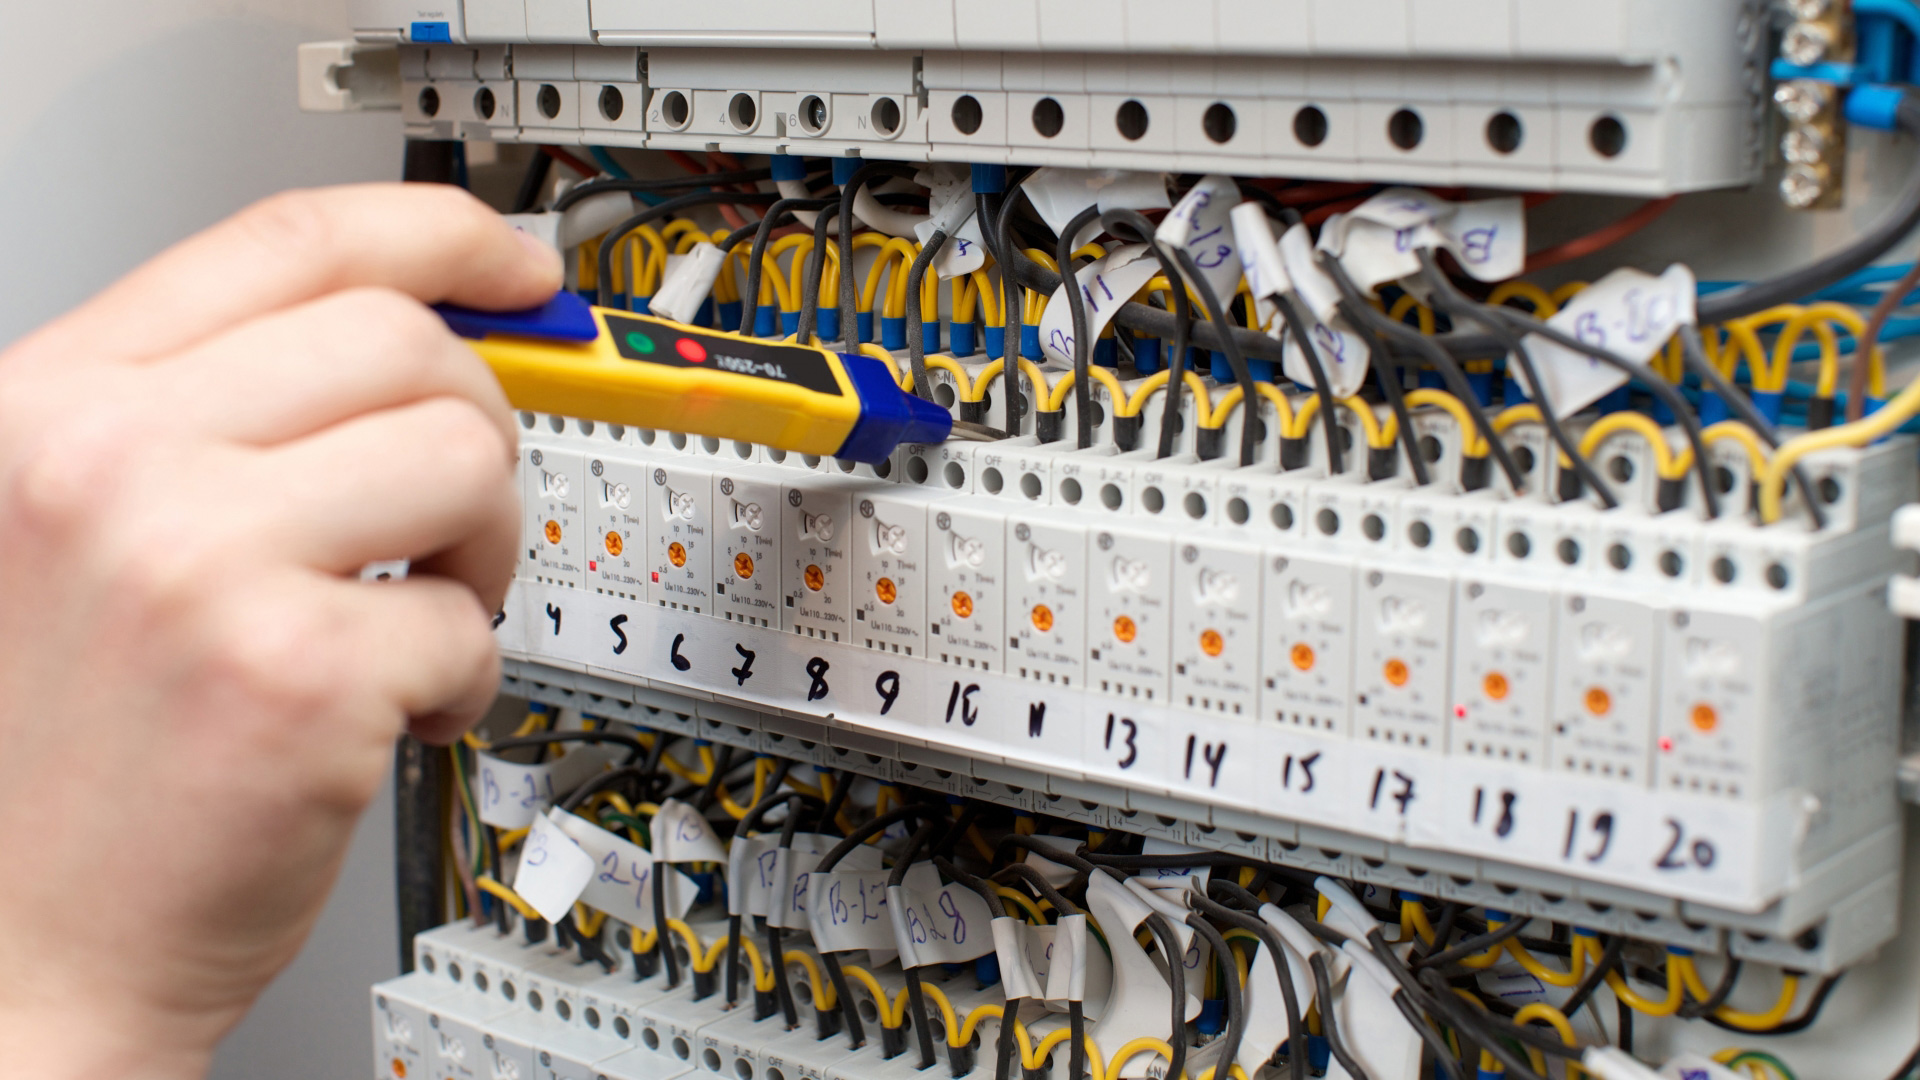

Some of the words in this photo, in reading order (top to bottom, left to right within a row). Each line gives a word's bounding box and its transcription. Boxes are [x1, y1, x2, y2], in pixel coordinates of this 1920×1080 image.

[651, 109, 659, 123] 2
[718, 112, 726, 126] 4
[789, 113, 797, 127] 6
[857, 115, 867, 130] N
[909, 445, 925, 456] OFF
[985, 455, 1002, 466] OFF
[547, 603, 561, 635] 4
[610, 614, 628, 654] 5
[671, 633, 691, 671] 6
[731, 643, 756, 687] 7
[806, 657, 830, 701] 8
[875, 670, 899, 715] 9
[1105, 712, 1138, 770] 13
[1185, 733, 1227, 788] 14
[1283, 750, 1321, 793] 15
[1370, 767, 1416, 815] 17
[1472, 786, 1517, 838] 18
[1561, 808, 1615, 863] 19
[1655, 818, 1718, 870] 20
[878, 765, 886, 777] 11
[895, 769, 904, 780] 14
[948, 782, 955, 793] 11
[965, 784, 973, 795] 14
[1019, 797, 1027, 809] 11
[1038, 800, 1047, 811] 14
[1094, 813, 1102, 825] 11
[1114, 815, 1123, 827] 14
[1172, 829, 1180, 841] 11
[1191, 829, 1200, 842] 14
[1252, 844, 1261, 857] 11
[1273, 848, 1283, 860] 14
[704, 1036, 719, 1048] OFF
[768, 1055, 783, 1068] OFF
